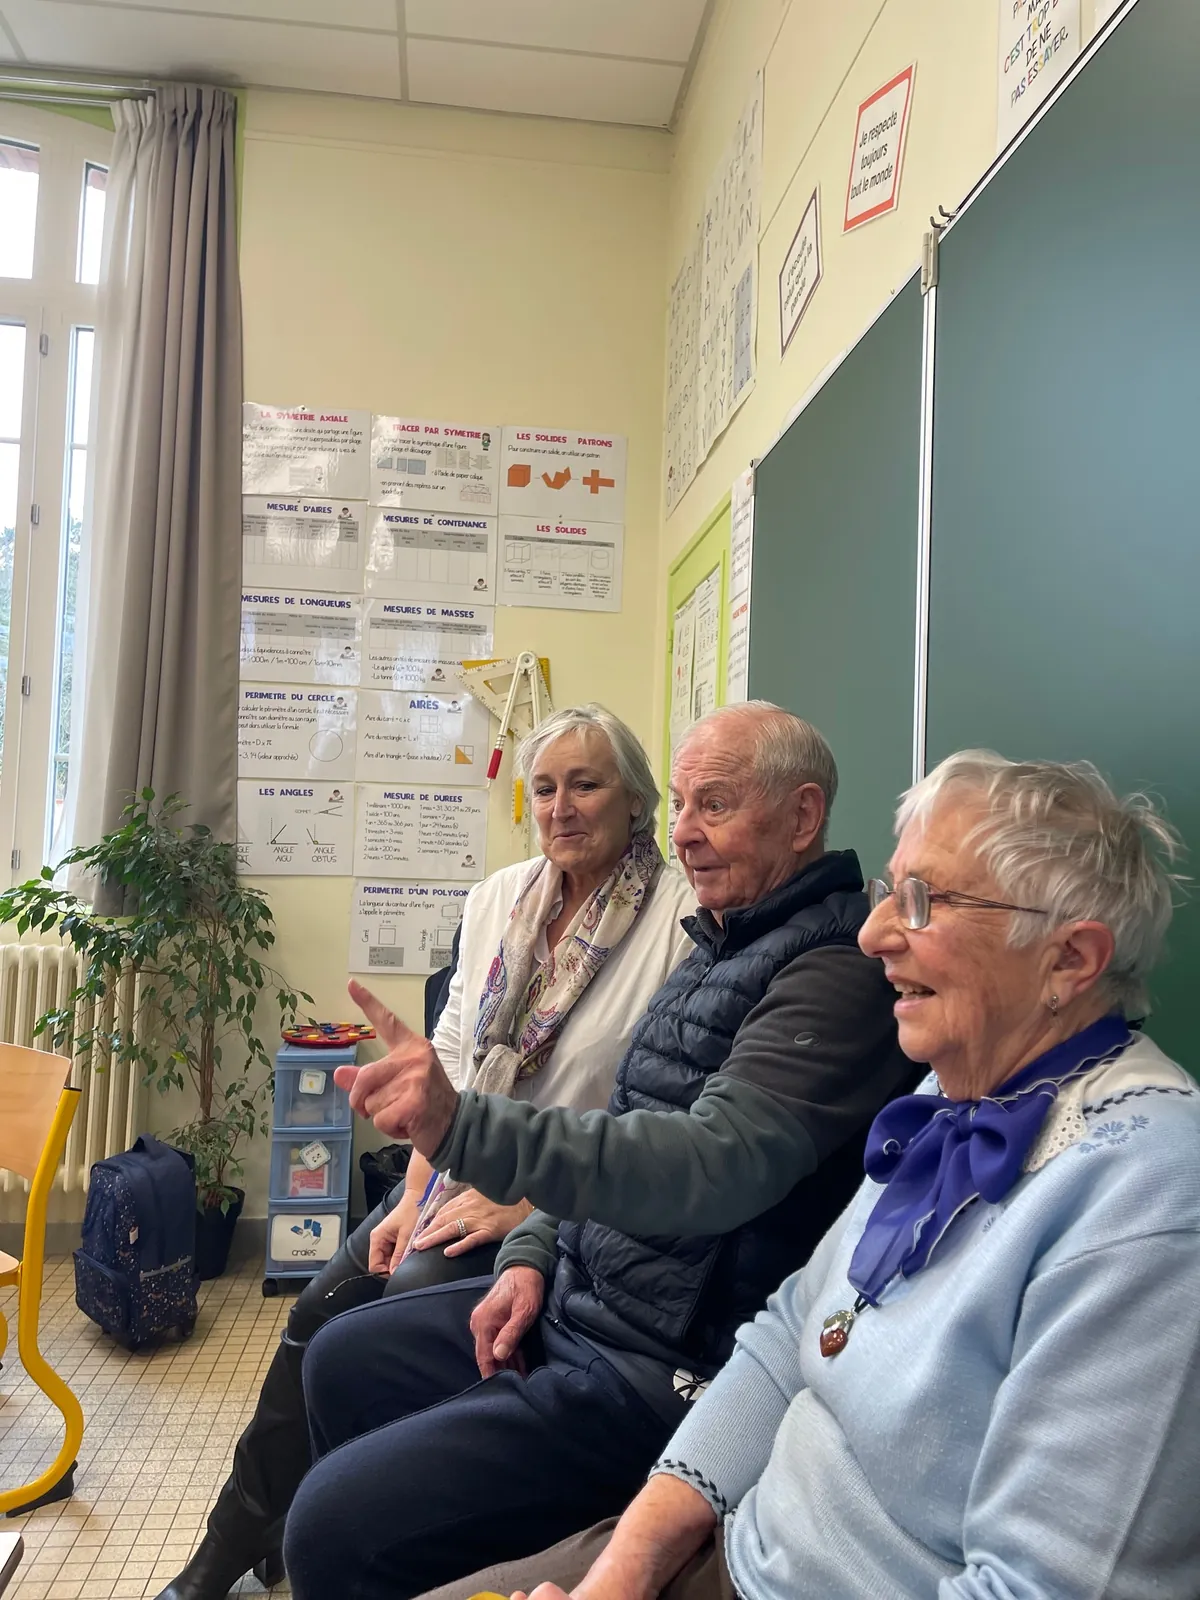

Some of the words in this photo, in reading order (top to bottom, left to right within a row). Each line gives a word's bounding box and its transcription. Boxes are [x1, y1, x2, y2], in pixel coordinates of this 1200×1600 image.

[1027, 2, 1050, 40] TROP
[1026, 39, 1038, 67] DE
[1039, 20, 1051, 48] NE
[1011, 76, 1025, 108] PAS
[859, 131, 867, 148] Je
[868, 111, 897, 142] respecte
[861, 143, 888, 170] toujours
[851, 179, 862, 199] tout
[862, 176, 868, 192] le
[869, 163, 893, 188] monde
[277, 412, 315, 421] SYMETRIE
[444, 429, 481, 439] SYMETRIE
[535, 434, 567, 443] SOLIDES
[578, 438, 612, 447] PATRONS
[267, 503, 298, 511] MESURE
[384, 515, 419, 524] MESURES
[438, 519, 487, 528] CONTENANCE
[555, 526, 587, 535] SOLIDES
[241, 595, 279, 603] MESURES
[300, 598, 351, 609] LONGUEURS
[384, 605, 421, 614] MESURES
[441, 609, 474, 618] MASSES
[245, 692, 286, 700] PERIMETRE
[409, 700, 439, 709] AIRES
[422, 901, 434, 909] figure
[291, 1249, 316, 1257] craies
